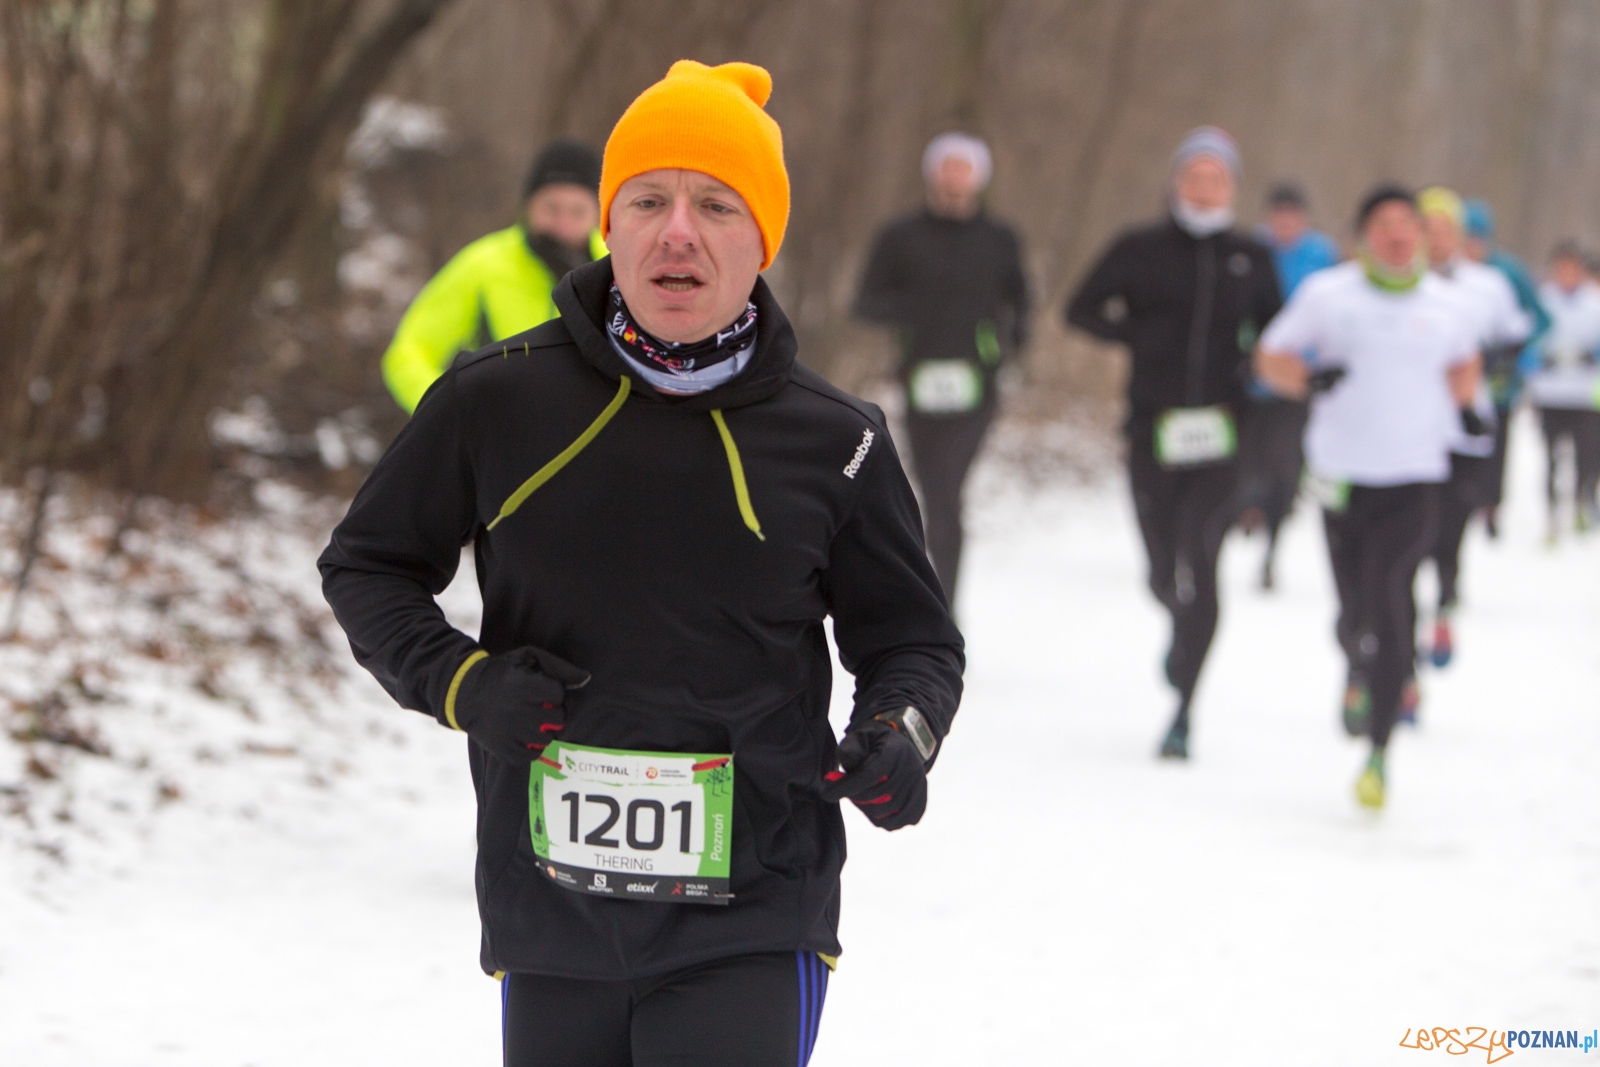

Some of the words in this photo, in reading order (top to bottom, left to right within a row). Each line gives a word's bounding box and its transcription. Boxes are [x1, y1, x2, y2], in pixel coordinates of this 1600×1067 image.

[843, 428, 875, 479] Reebok
[561, 791, 692, 853] 1201
[710, 813, 725, 862] Poznań
[594, 853, 654, 872] THERING
